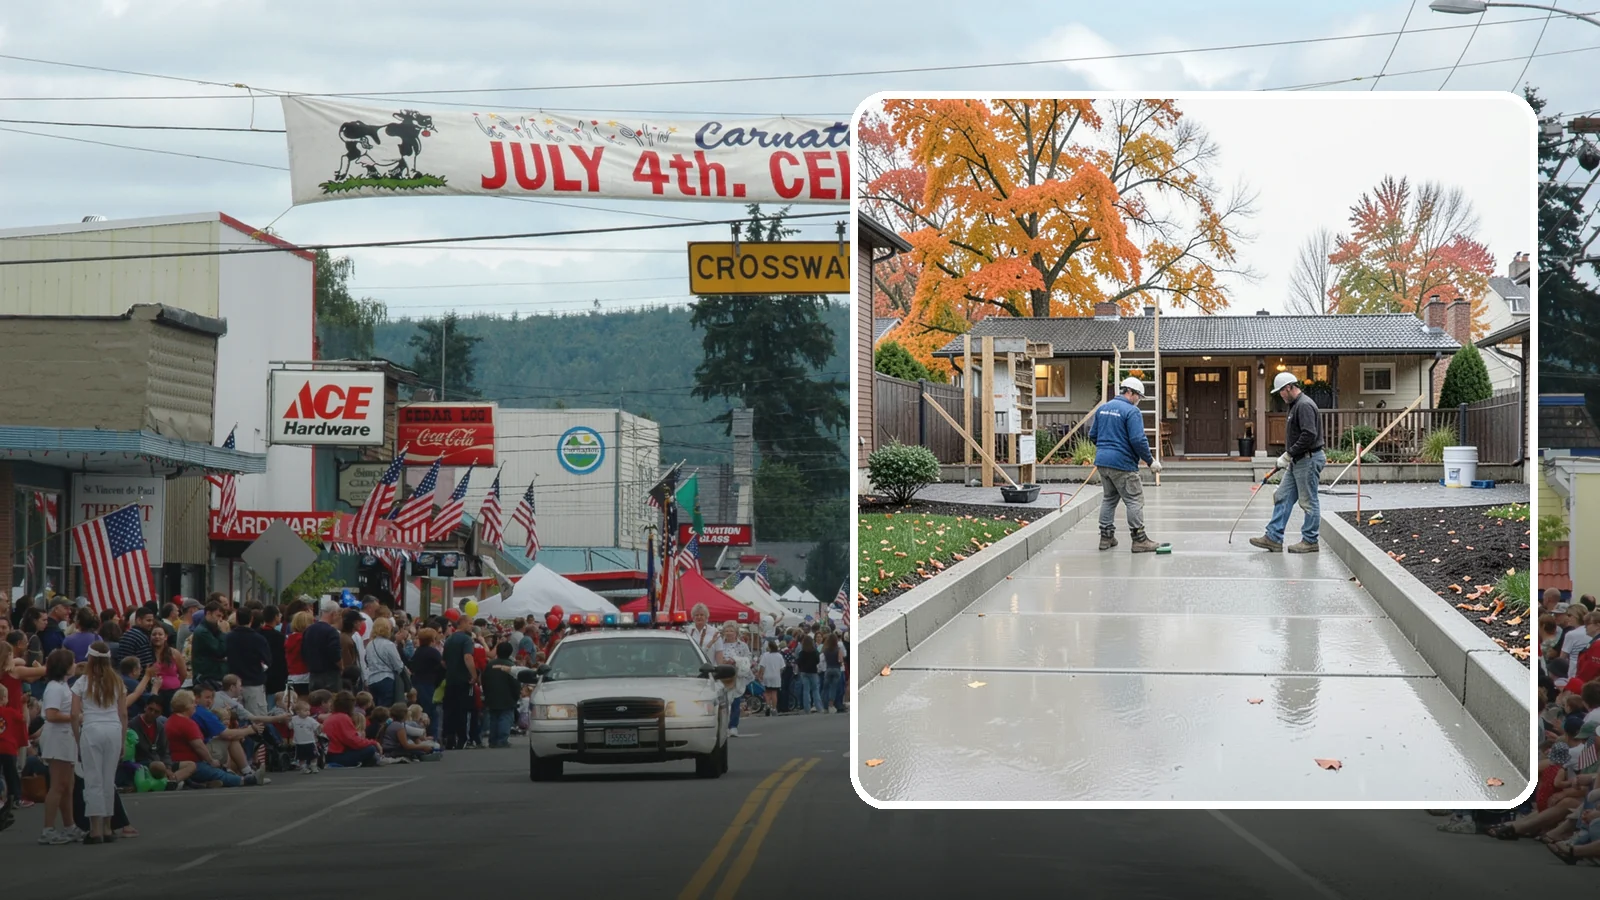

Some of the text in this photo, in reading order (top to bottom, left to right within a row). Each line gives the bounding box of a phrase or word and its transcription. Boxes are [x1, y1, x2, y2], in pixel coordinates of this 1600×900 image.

[695, 121, 850, 149] Carnat
[481, 140, 605, 192] JULY
[632, 149, 746, 198] 4th.
[697, 254, 850, 280] CROSSWA
[282, 379, 374, 420] ACE
[405, 408, 486, 423] CEDAR LOG
[283, 421, 370, 437] Hardware
[416, 428, 477, 447] Coca-Cola
[353, 466, 387, 480] Simpl
[95, 485, 124, 495] Vincent
[126, 485, 136, 495] de
[138, 486, 155, 495] Paul
[81, 503, 154, 522] THT
[688, 526, 741, 535] CRNATION
[699, 535, 730, 543] GLASS
